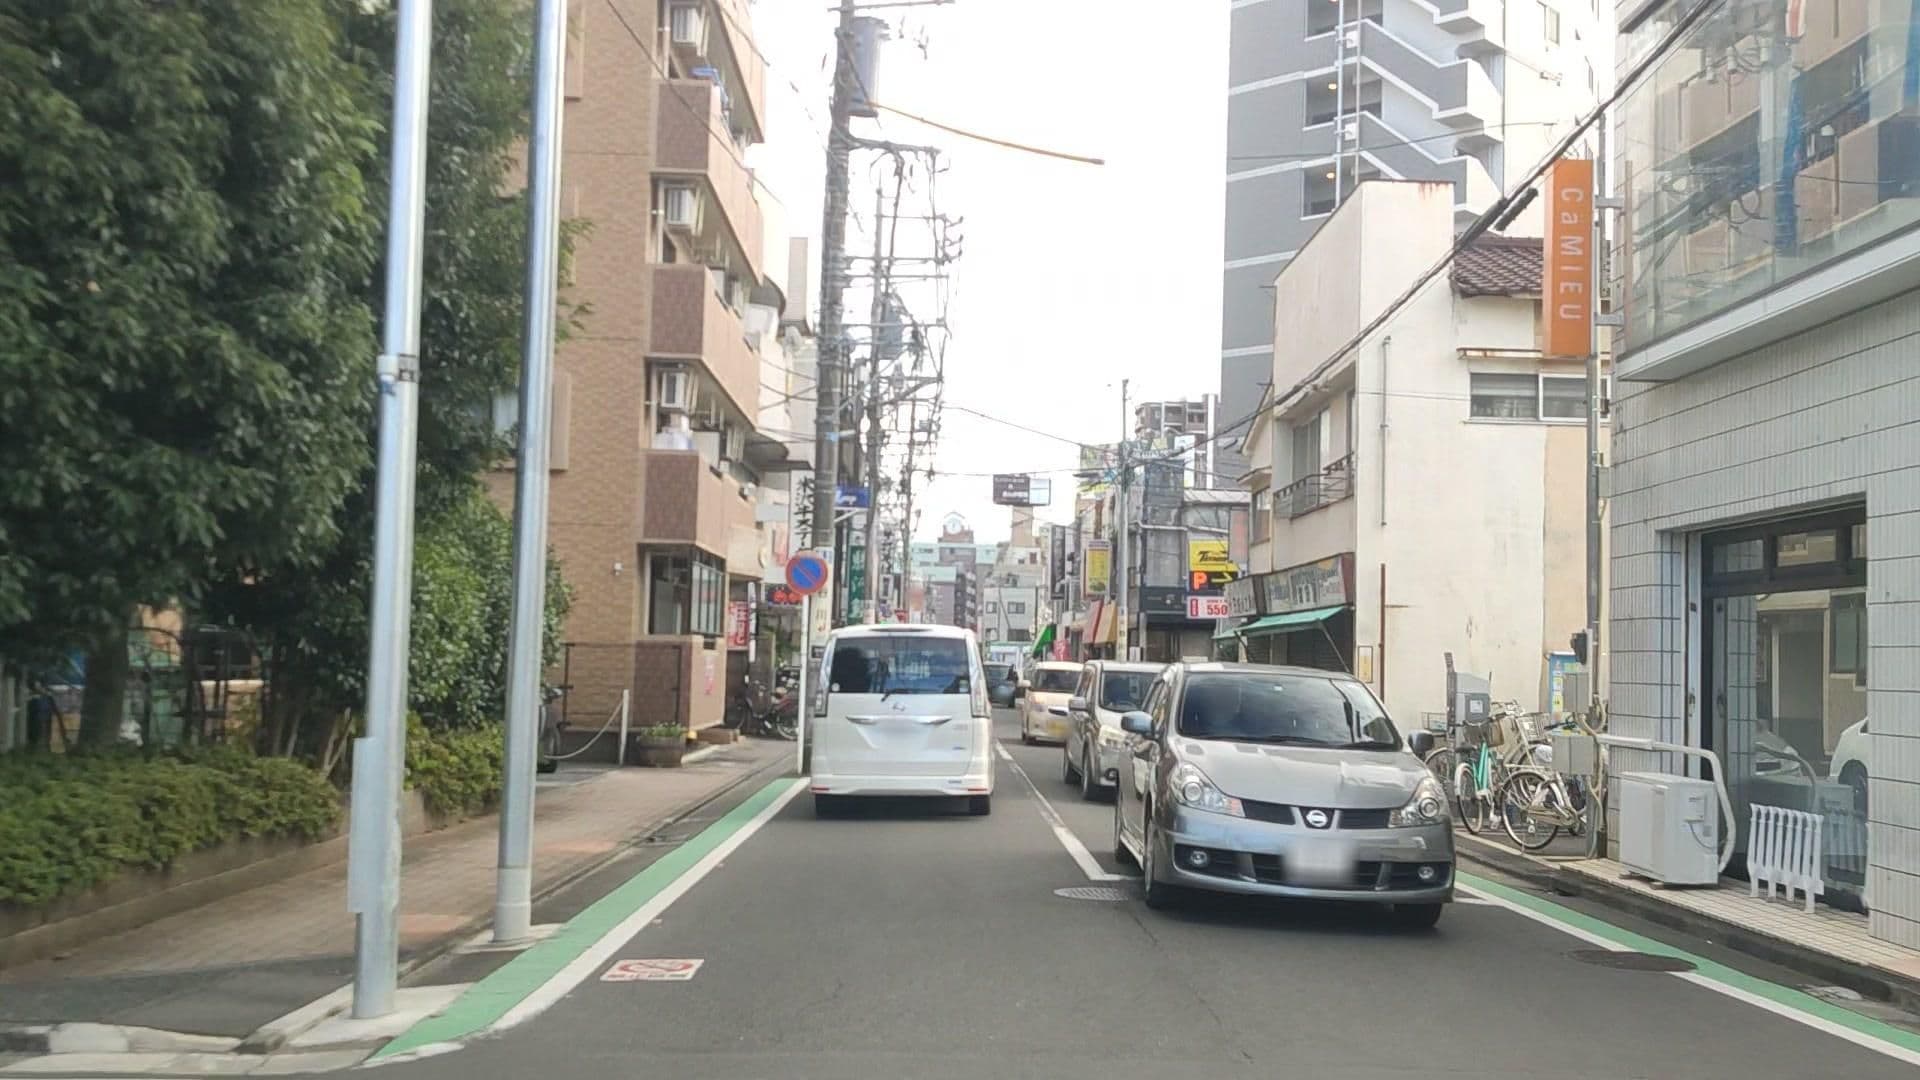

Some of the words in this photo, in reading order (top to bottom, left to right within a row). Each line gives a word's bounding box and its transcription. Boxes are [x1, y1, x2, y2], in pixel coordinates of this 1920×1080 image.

[1560, 188, 1584, 319] CaMIEU
[1193, 570, 1208, 590] P
[1206, 604, 1228, 616] 550
